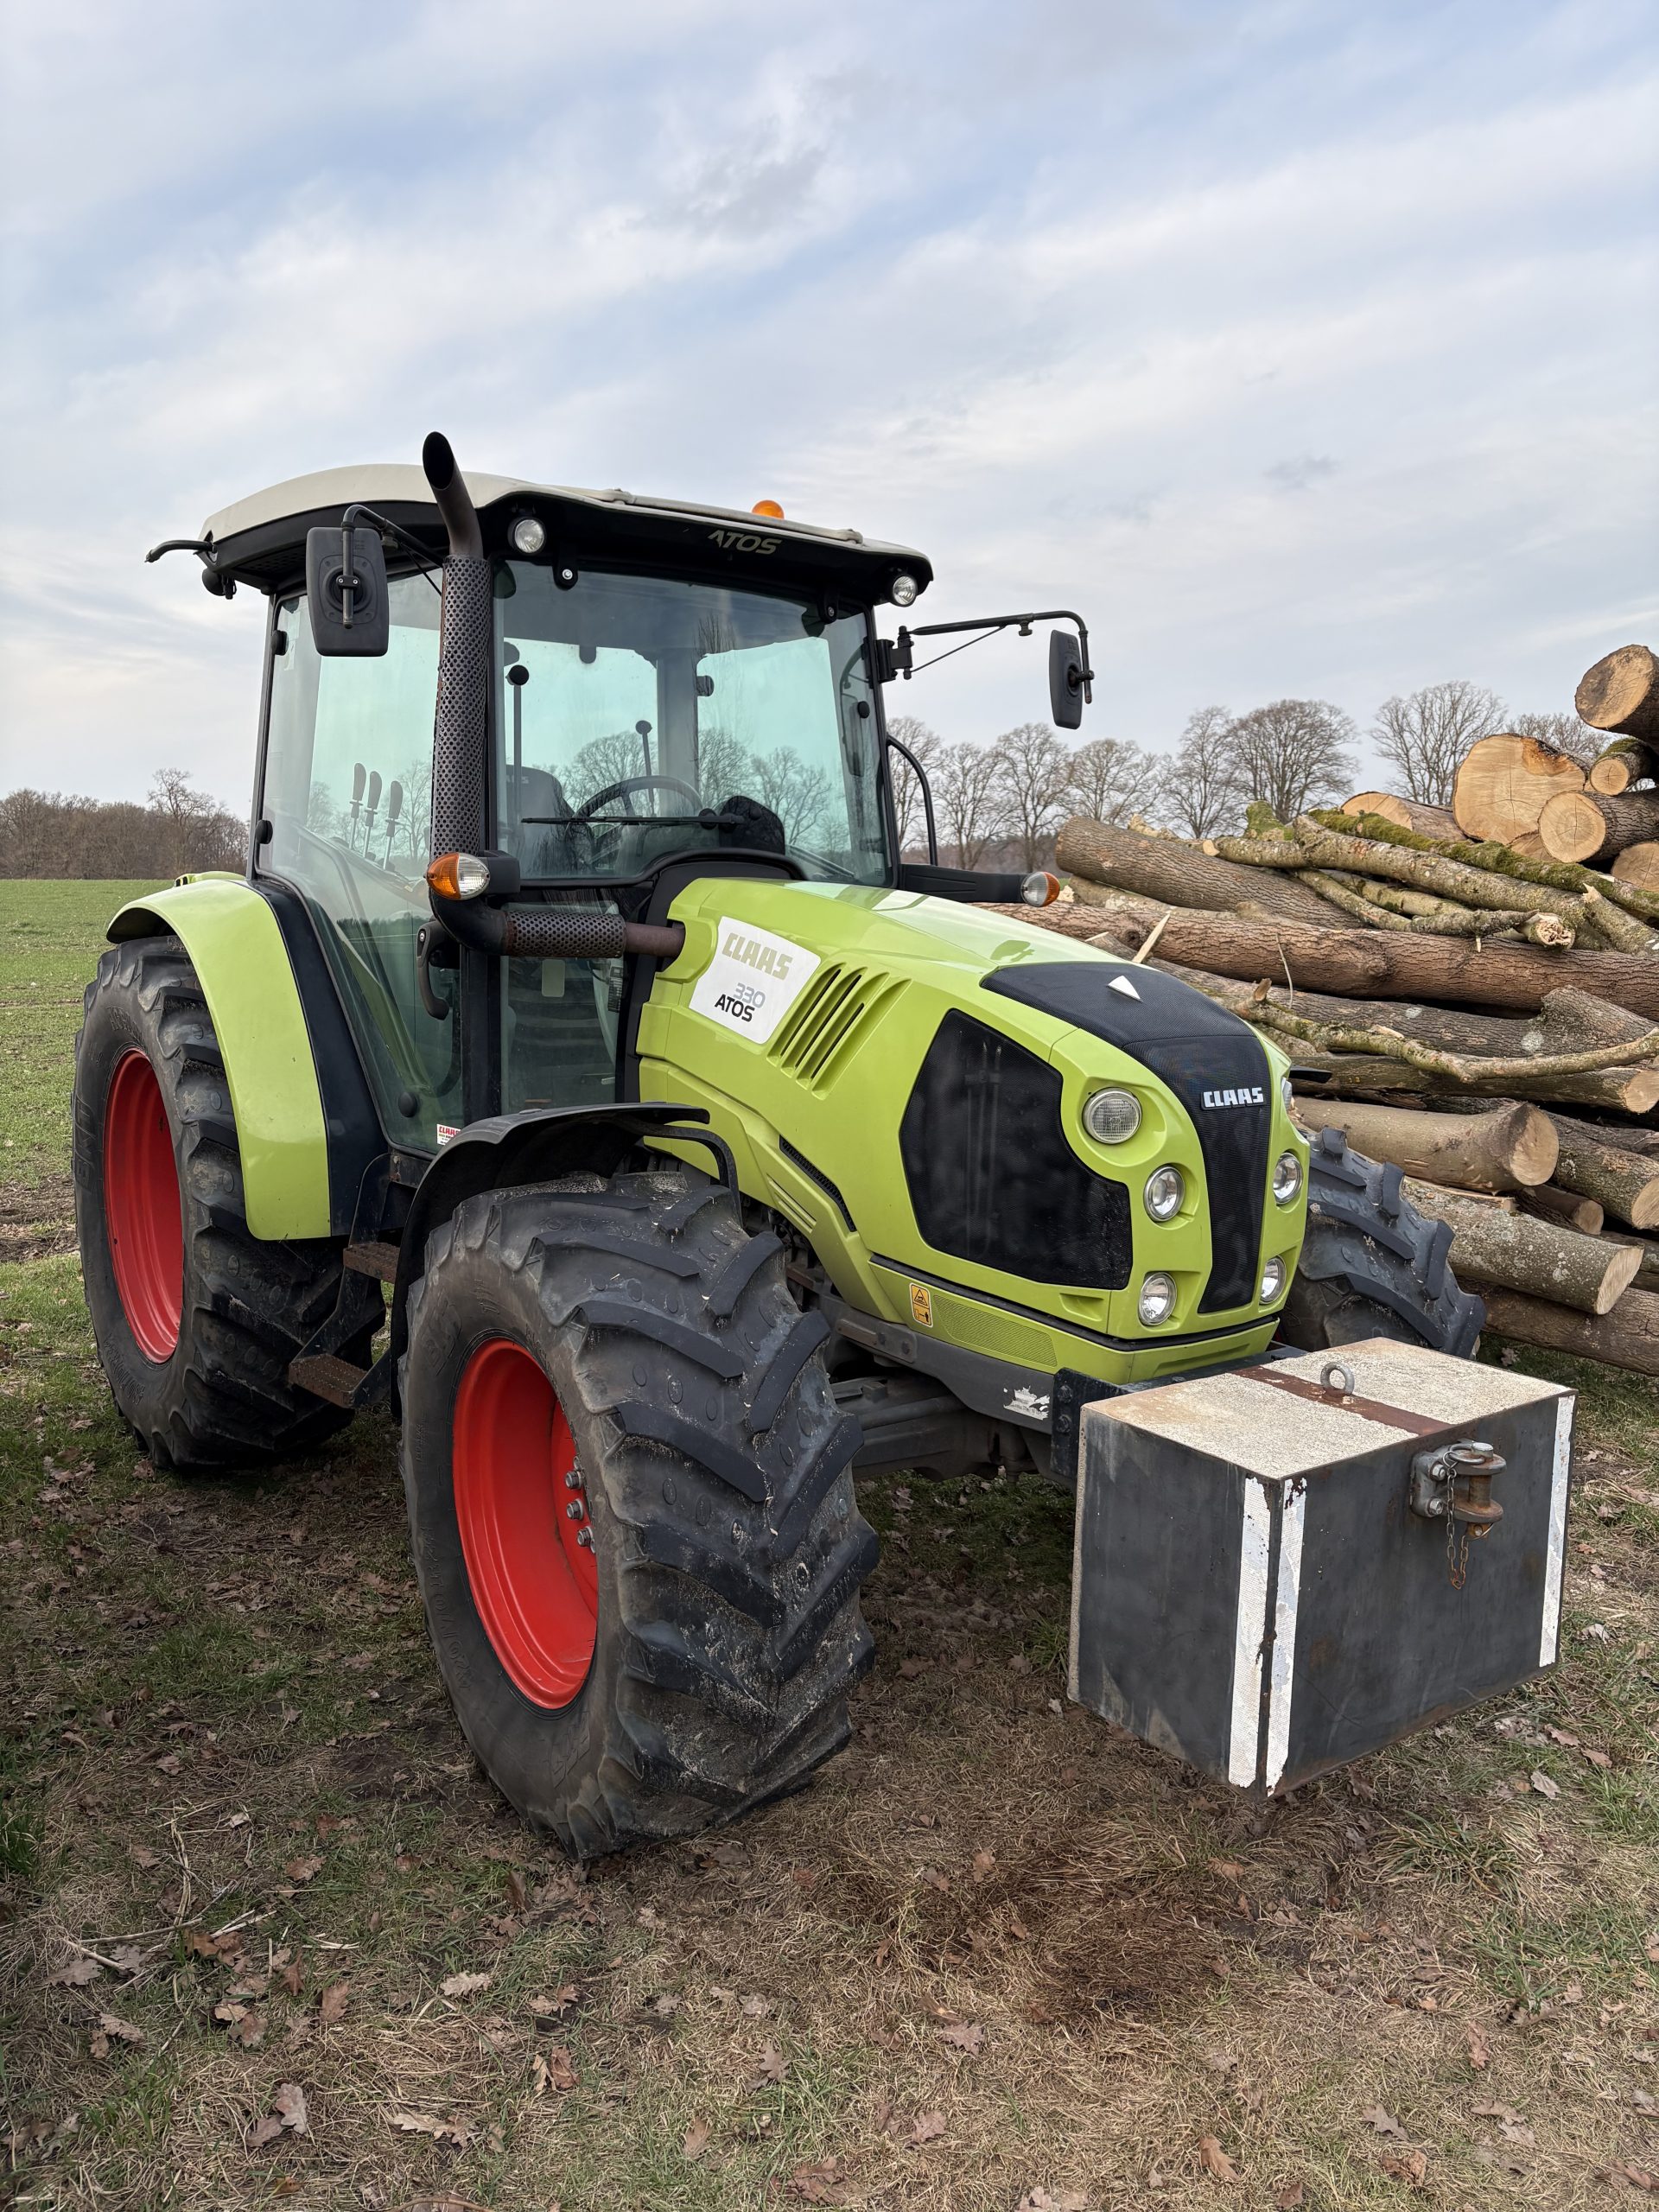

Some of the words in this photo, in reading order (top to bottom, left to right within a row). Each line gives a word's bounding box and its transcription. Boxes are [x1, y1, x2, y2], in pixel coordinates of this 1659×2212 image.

[708, 530, 782, 555] ATOS
[721, 932, 793, 981] CLAAS
[715, 994, 755, 1022] ATOS
[733, 982, 766, 1008] 330
[1203, 1087, 1264, 1108] CLAAS
